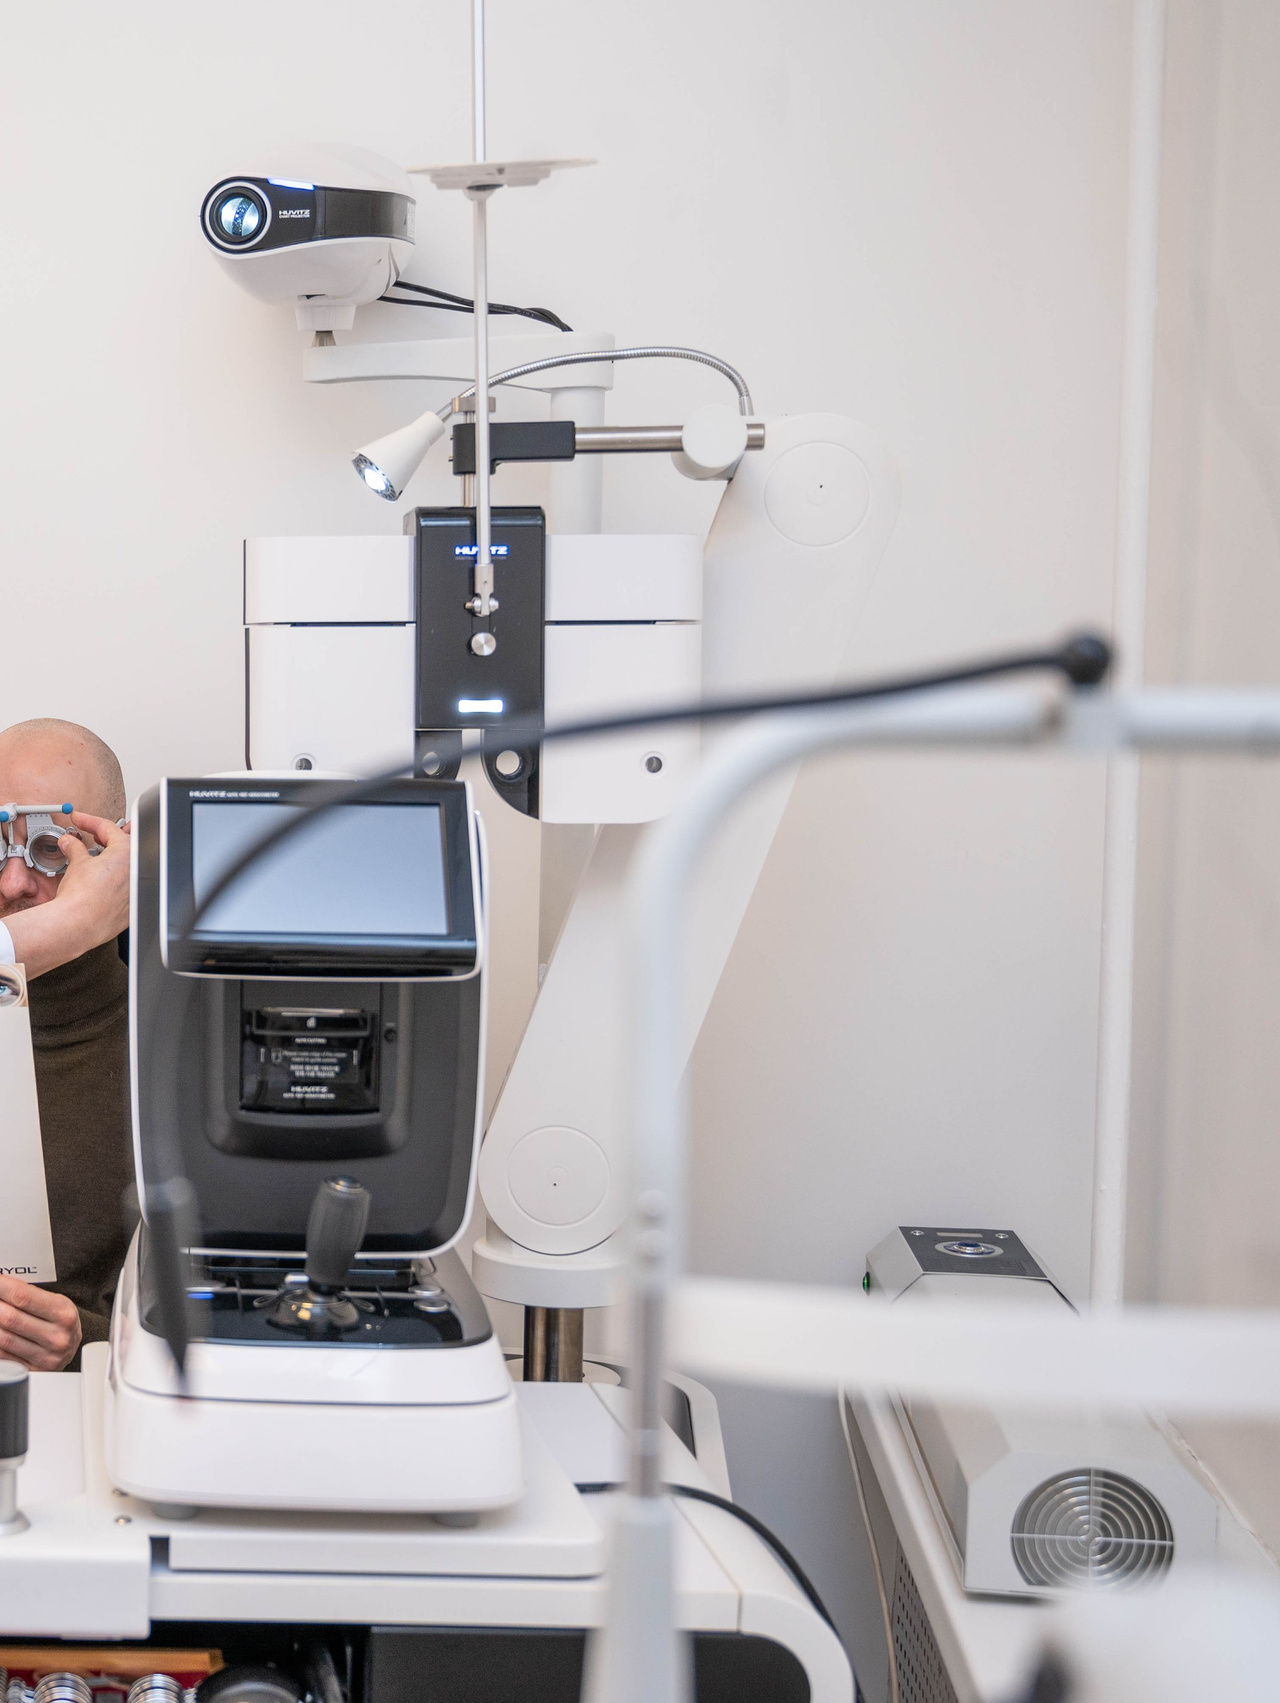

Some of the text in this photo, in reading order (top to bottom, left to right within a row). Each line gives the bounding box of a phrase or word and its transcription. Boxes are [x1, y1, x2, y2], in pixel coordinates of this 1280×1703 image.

[455, 546, 508, 555] HUTZ
[189, 790, 226, 798] HUVITZ
[291, 1085, 328, 1093] HUVITZ
